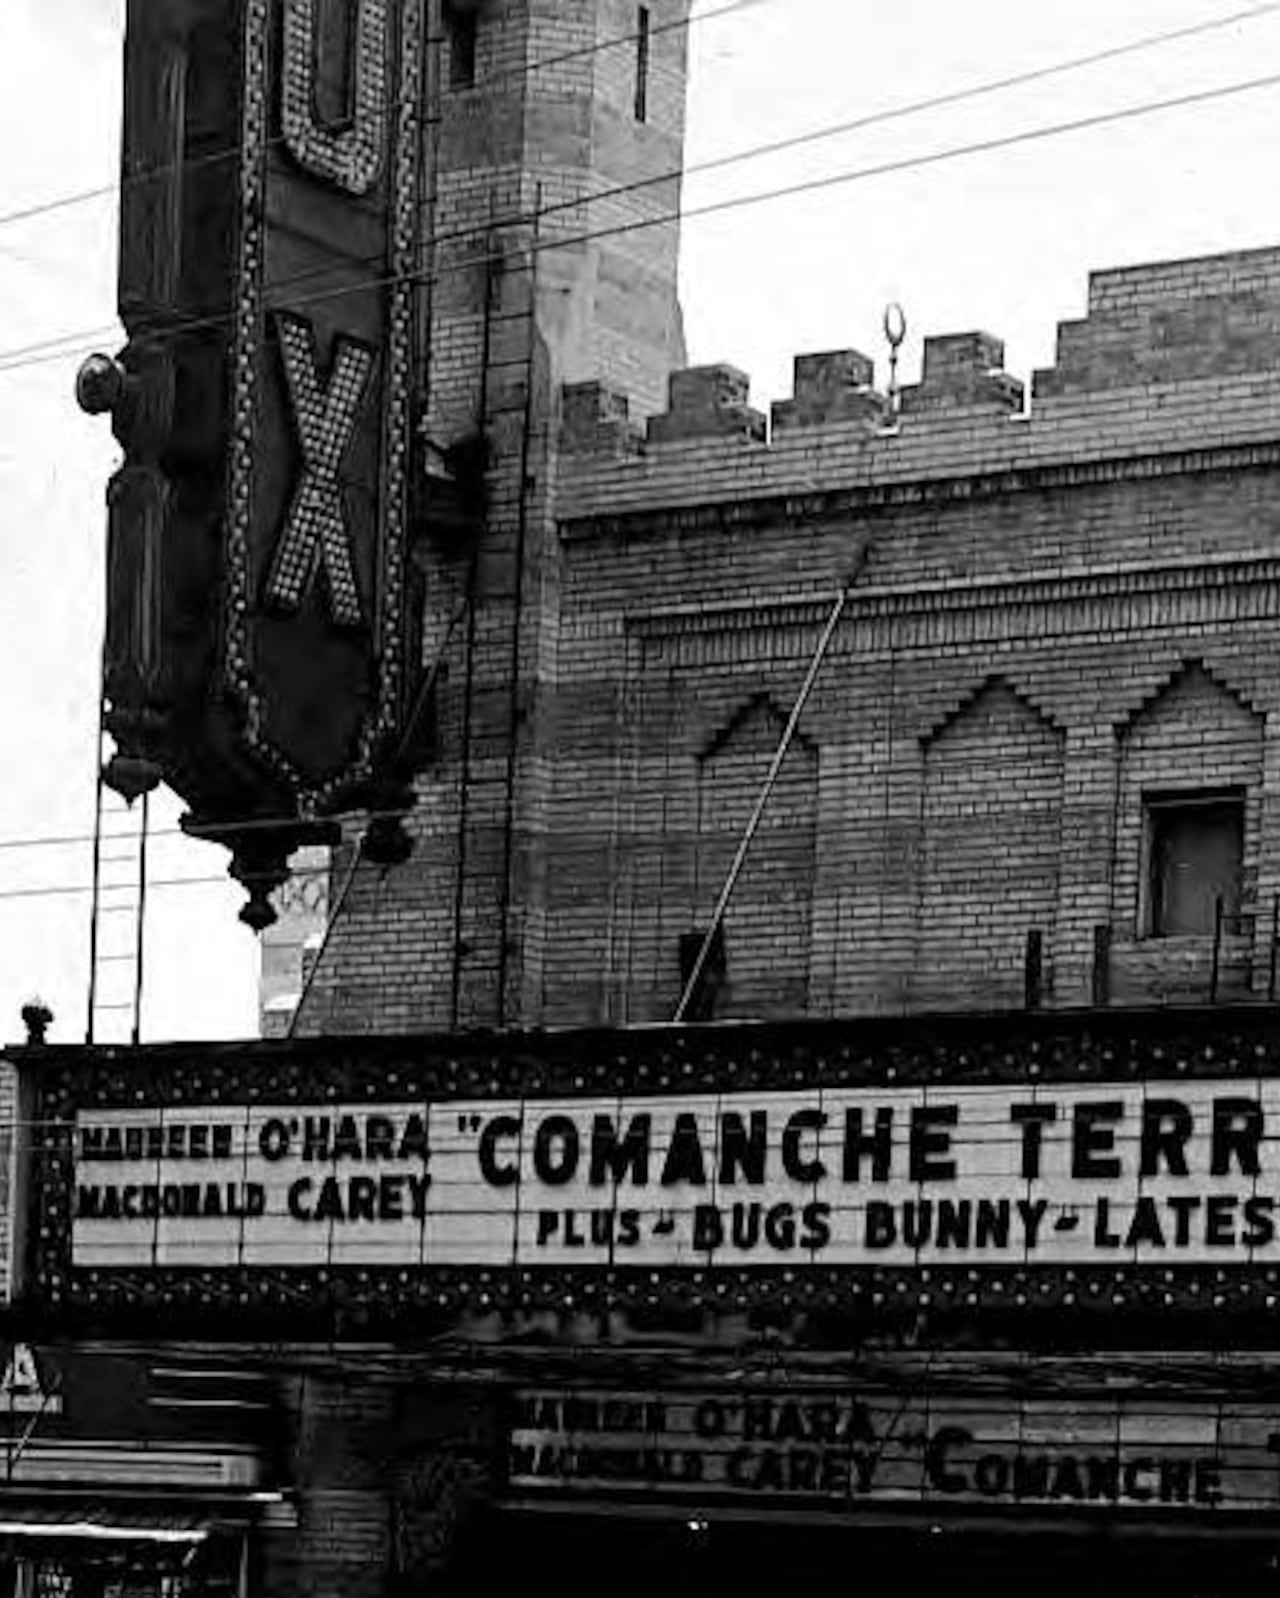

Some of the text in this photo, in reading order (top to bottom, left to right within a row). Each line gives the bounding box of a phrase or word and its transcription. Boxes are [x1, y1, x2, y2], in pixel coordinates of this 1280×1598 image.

[258, 1113, 431, 1162] O'HARA
[77, 1173, 433, 1223] MACDONALD CAREY
